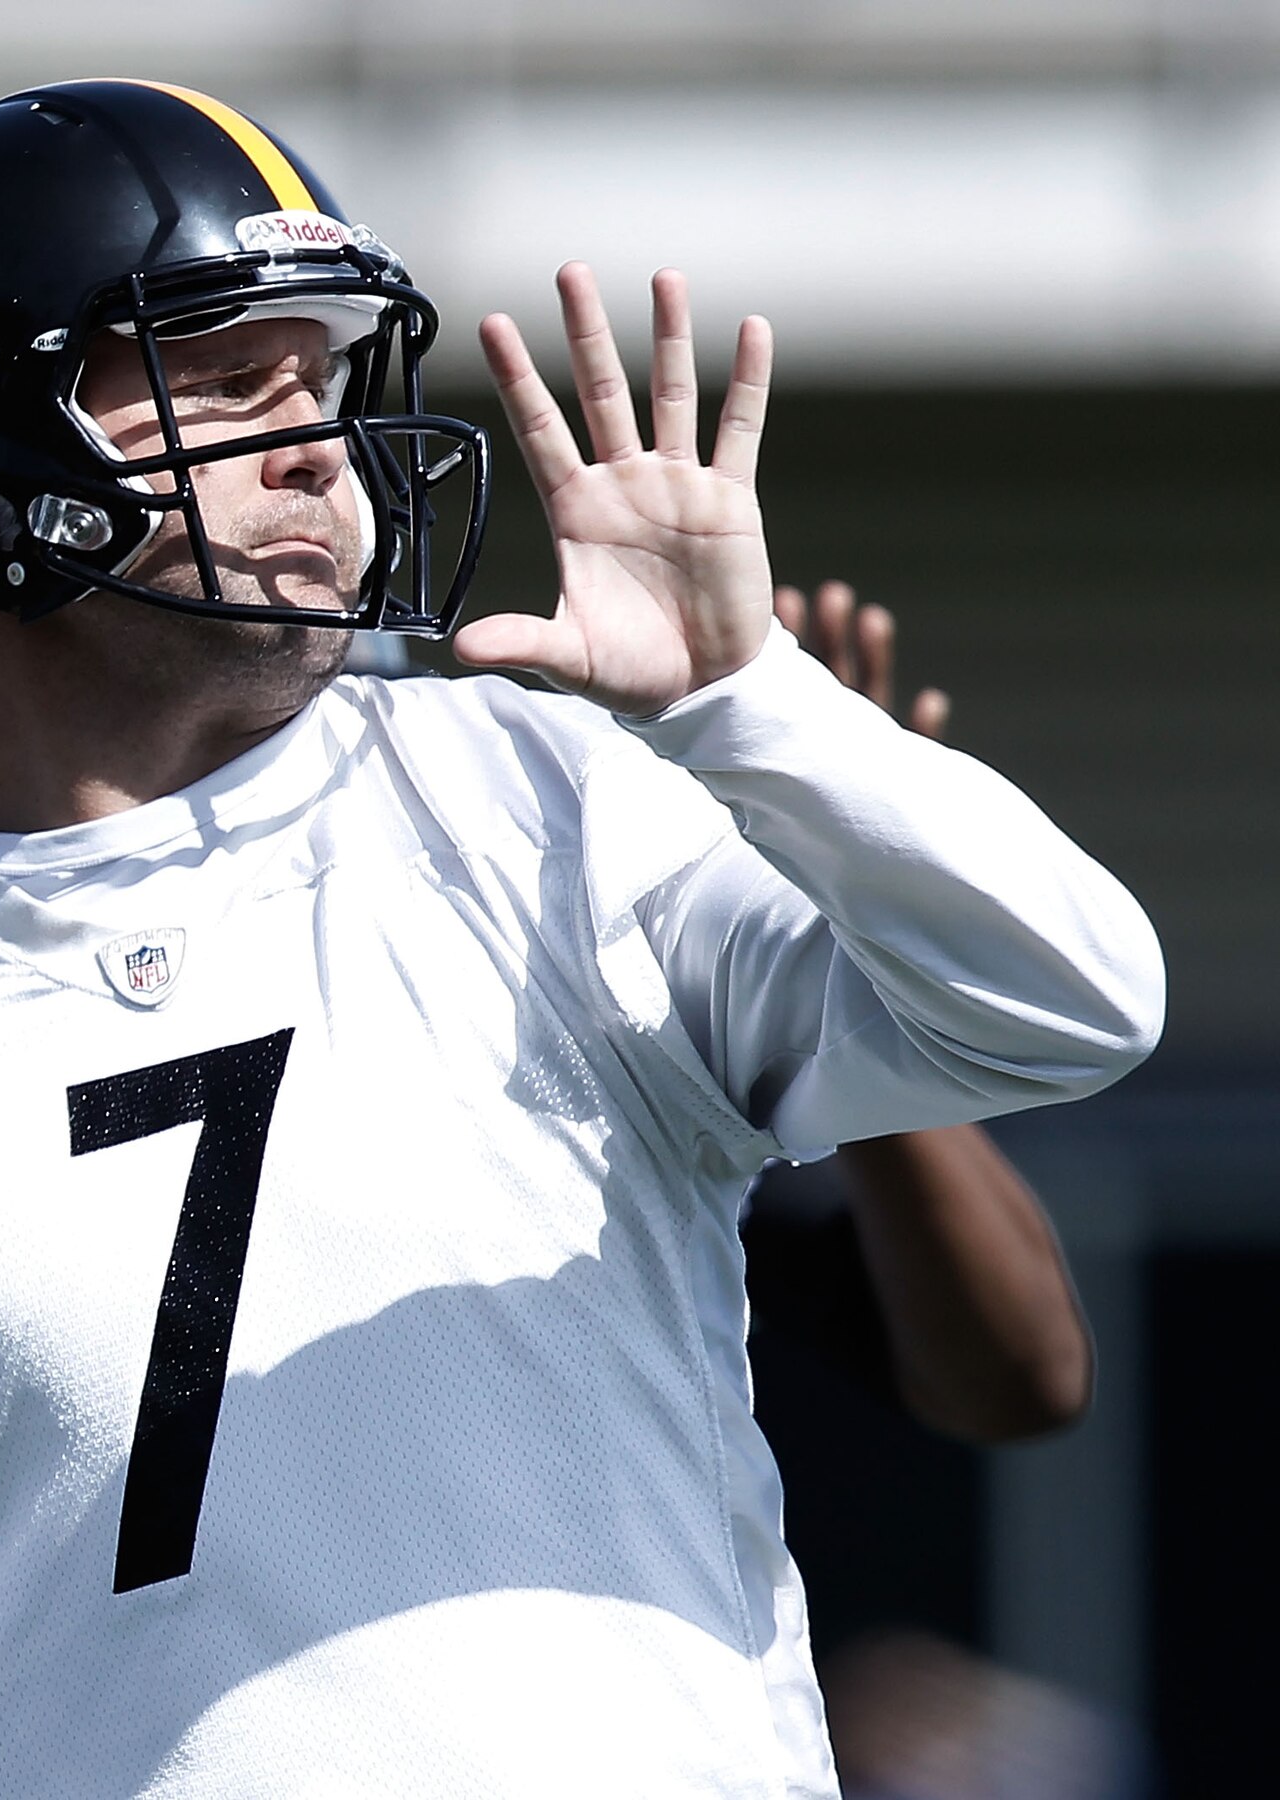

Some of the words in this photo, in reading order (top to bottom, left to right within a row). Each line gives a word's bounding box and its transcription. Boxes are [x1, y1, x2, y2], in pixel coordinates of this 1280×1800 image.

[275, 218, 348, 245] Riddell
[131, 964, 166, 988] NFL
[66, 1027, 297, 1595] 7
